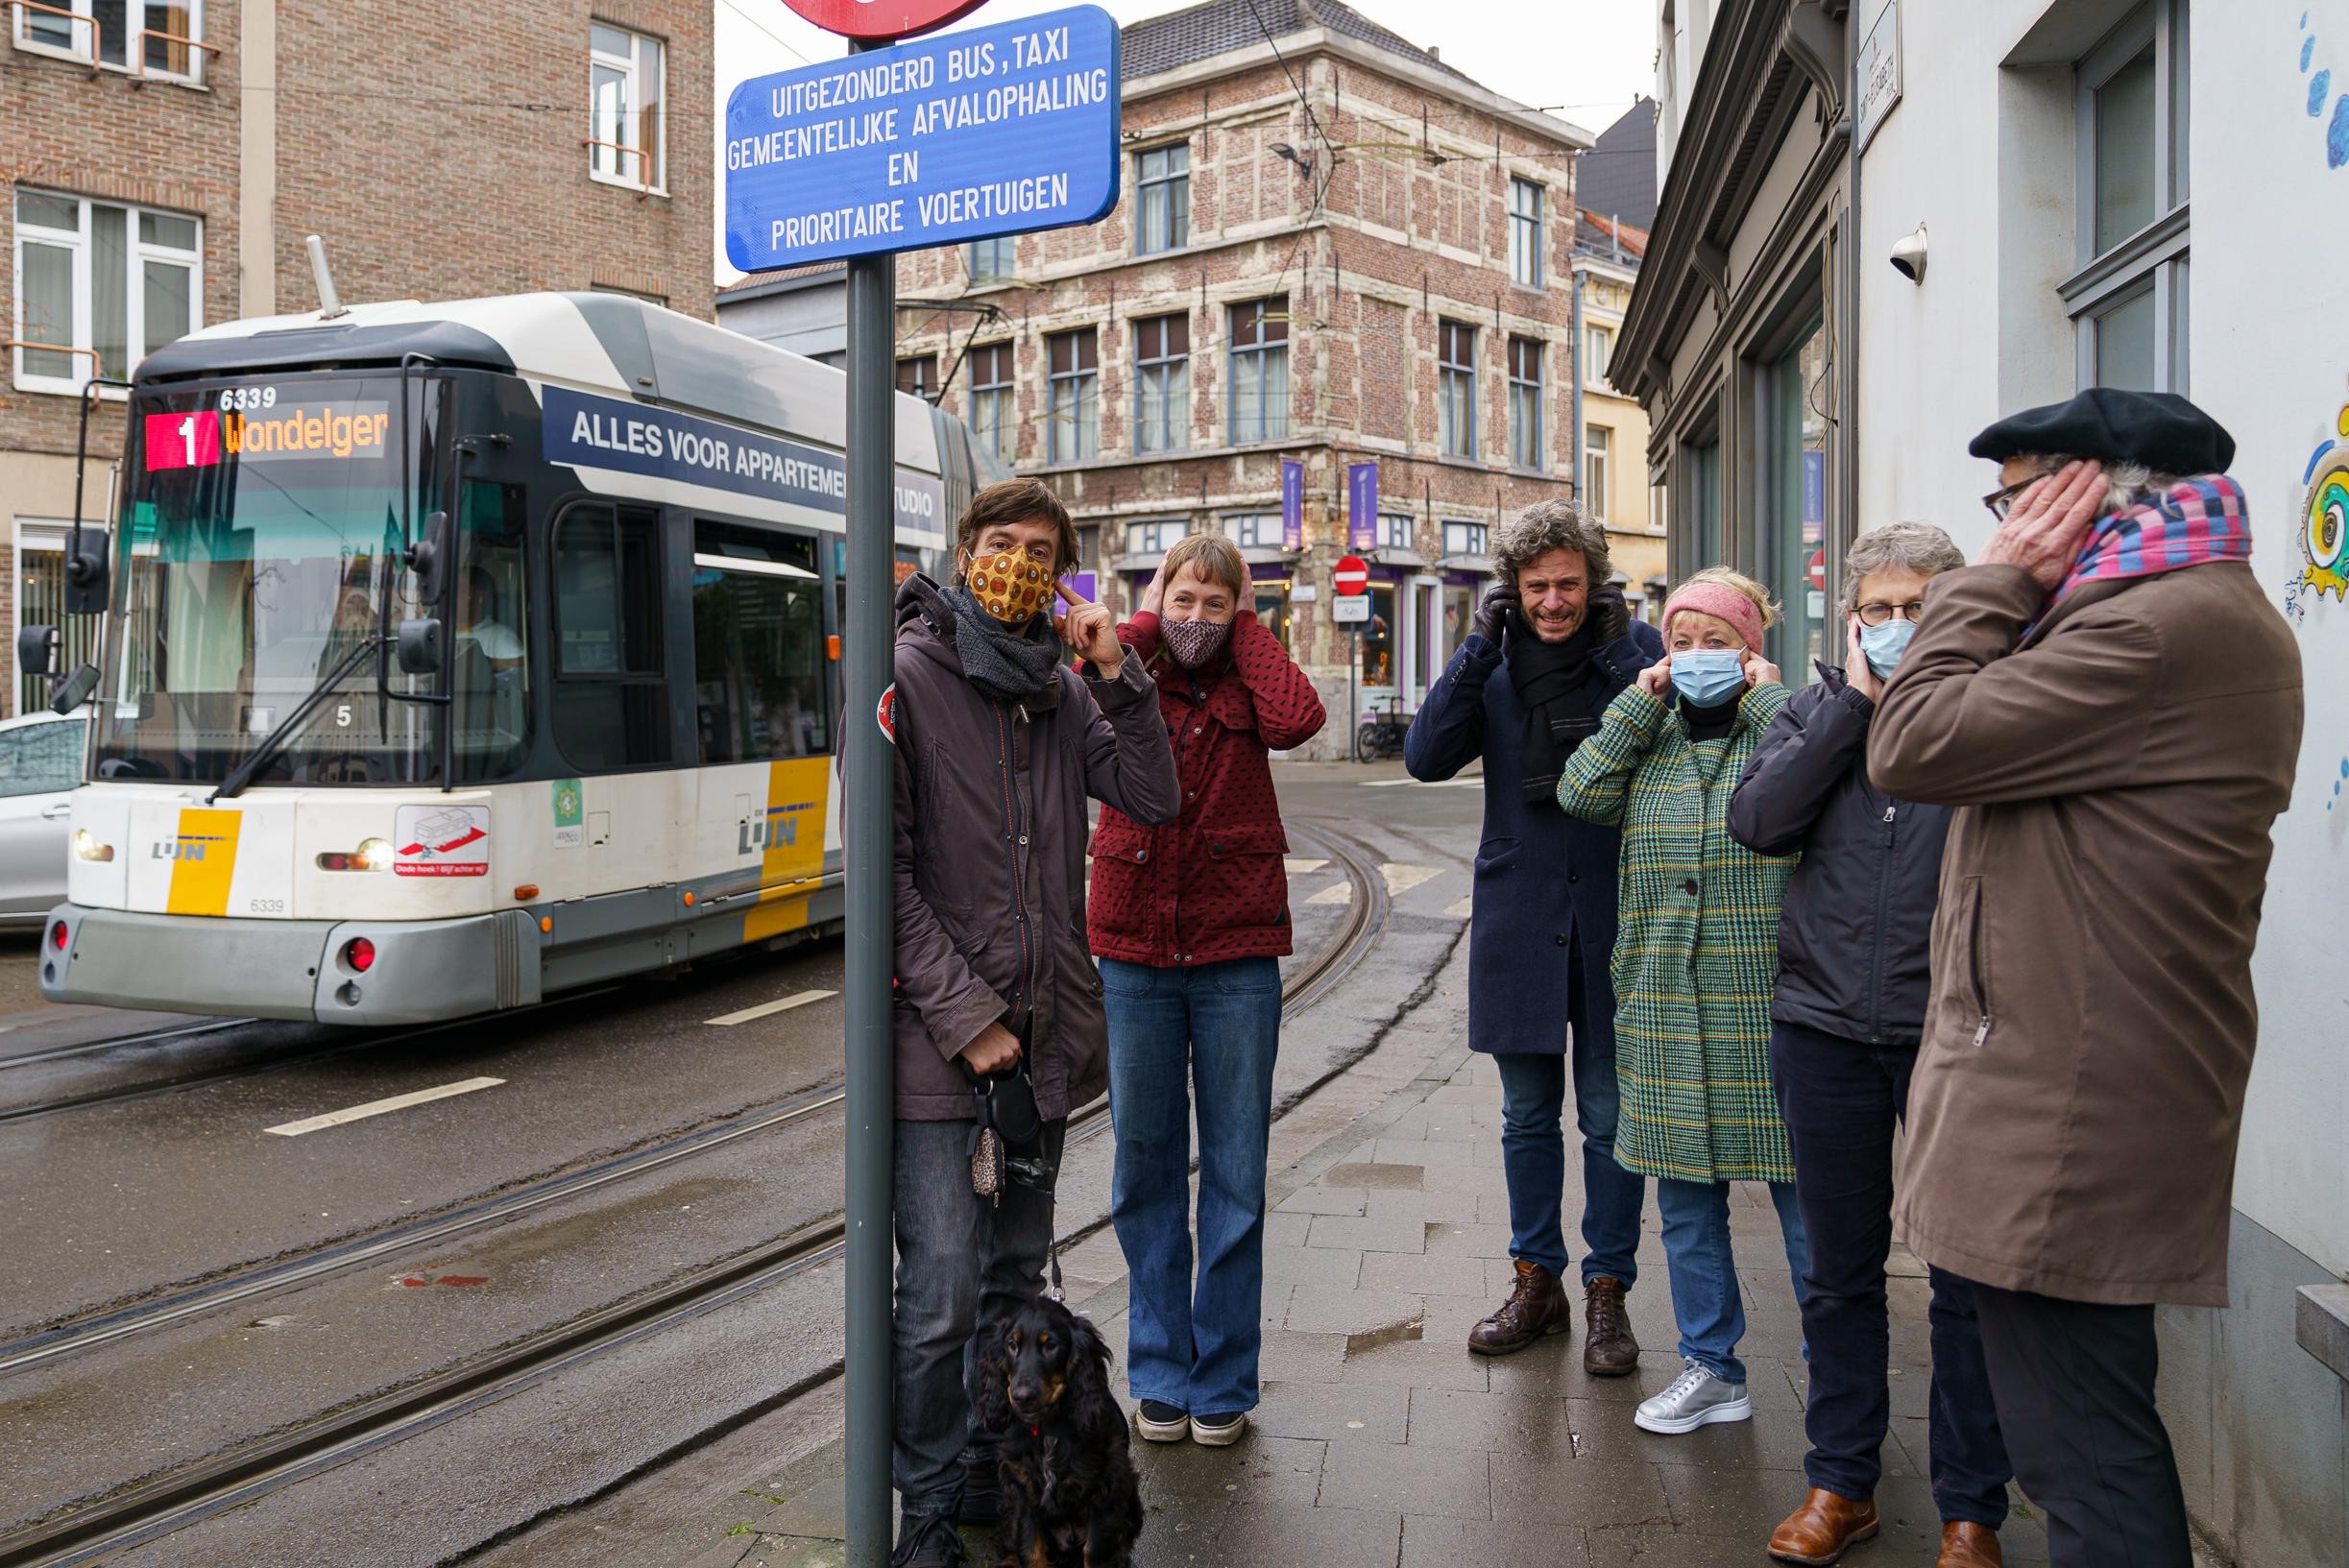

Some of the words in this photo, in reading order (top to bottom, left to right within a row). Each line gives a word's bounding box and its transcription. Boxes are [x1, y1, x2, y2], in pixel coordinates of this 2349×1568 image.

[771, 56, 934, 118] UITGEZONDERD
[727, 109, 899, 171] GEMEENTELIJKE
[912, 68, 1107, 136] AFVALOPHALING
[887, 151, 919, 186] EN
[771, 199, 905, 251] PRIORITAIRE
[917, 173, 1068, 228] VOERTUIGEN
[220, 386, 277, 411] 6339
[179, 417, 196, 466] 1
[571, 410, 664, 458] ALLES
[667, 428, 731, 471] VOOR
[735, 446, 847, 499] APPARTEME
[336, 705, 351, 727] 5
[152, 842, 206, 860] LIJN
[739, 817, 798, 856] LIJN
[250, 899, 284, 912] 6339
